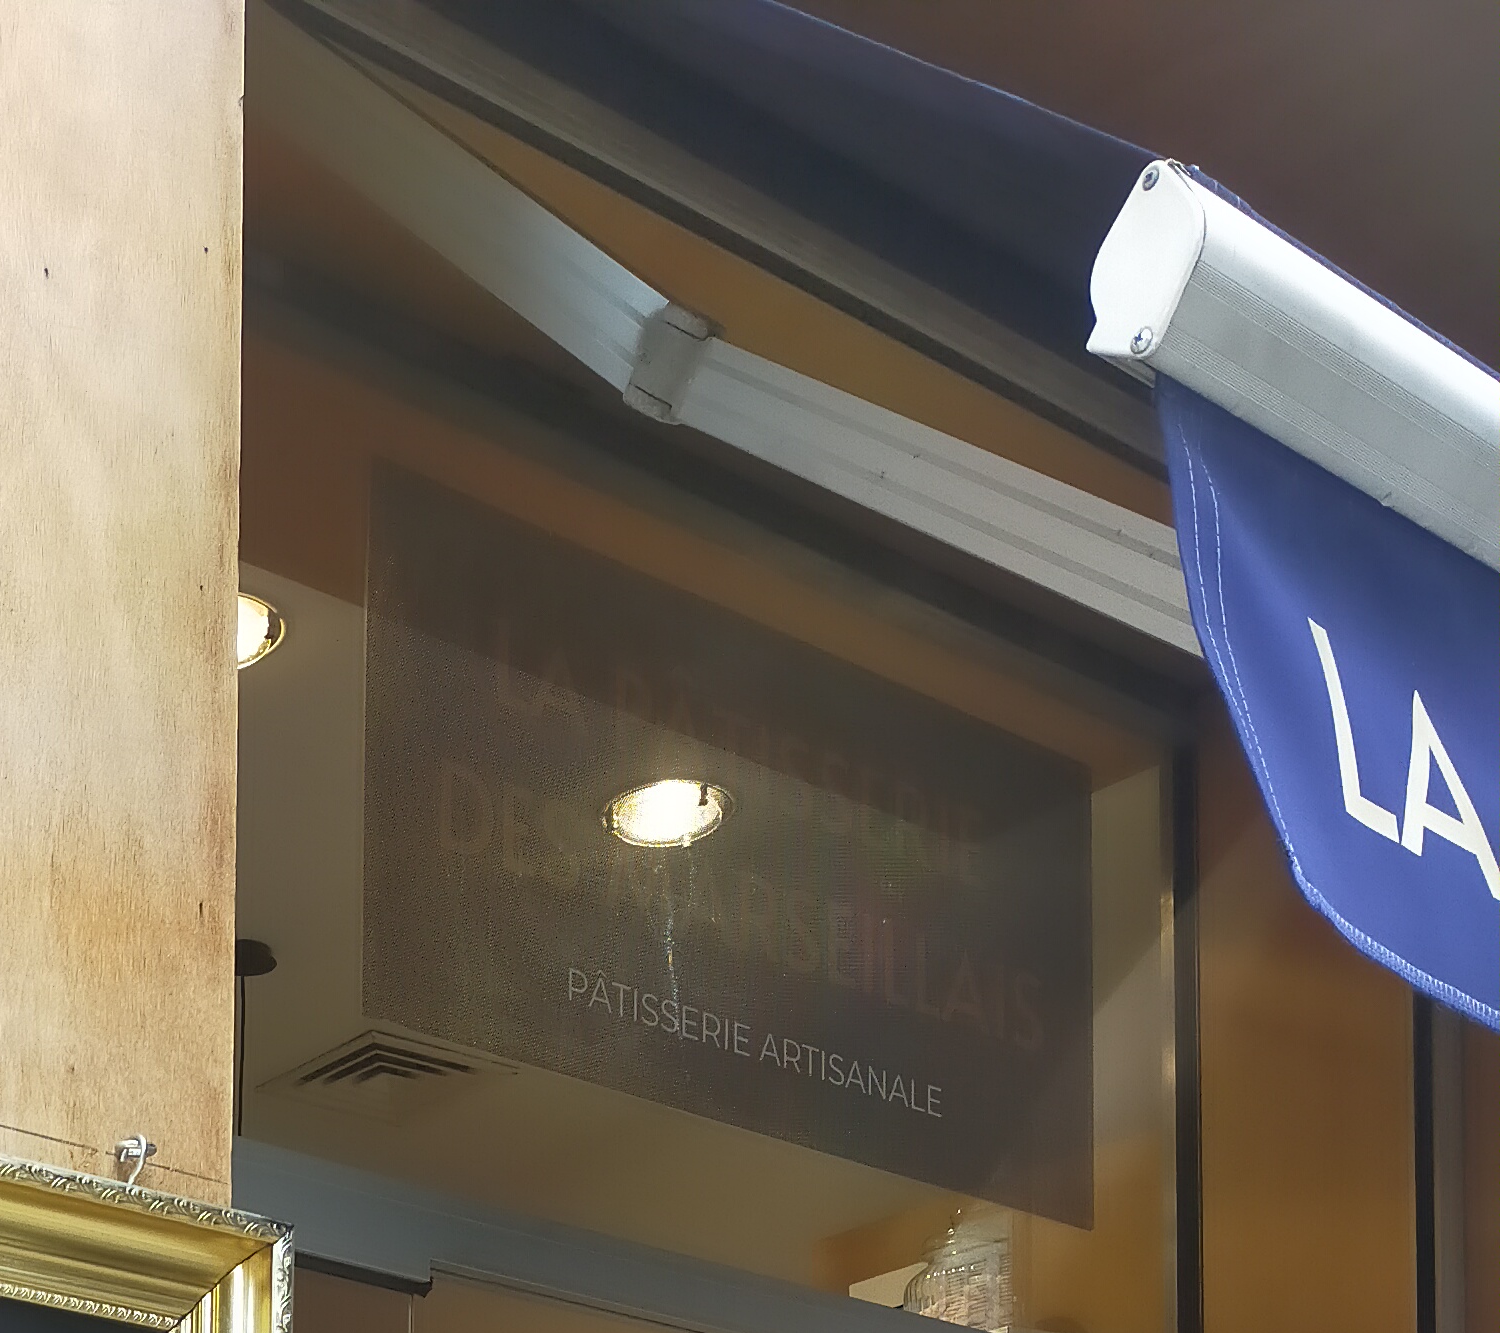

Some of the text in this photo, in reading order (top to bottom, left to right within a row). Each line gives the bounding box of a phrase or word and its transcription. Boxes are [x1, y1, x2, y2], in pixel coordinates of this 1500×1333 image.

[1308, 616, 1500, 902] LA
[567, 967, 943, 1118] PÂTISSERIE ARTISANALE
